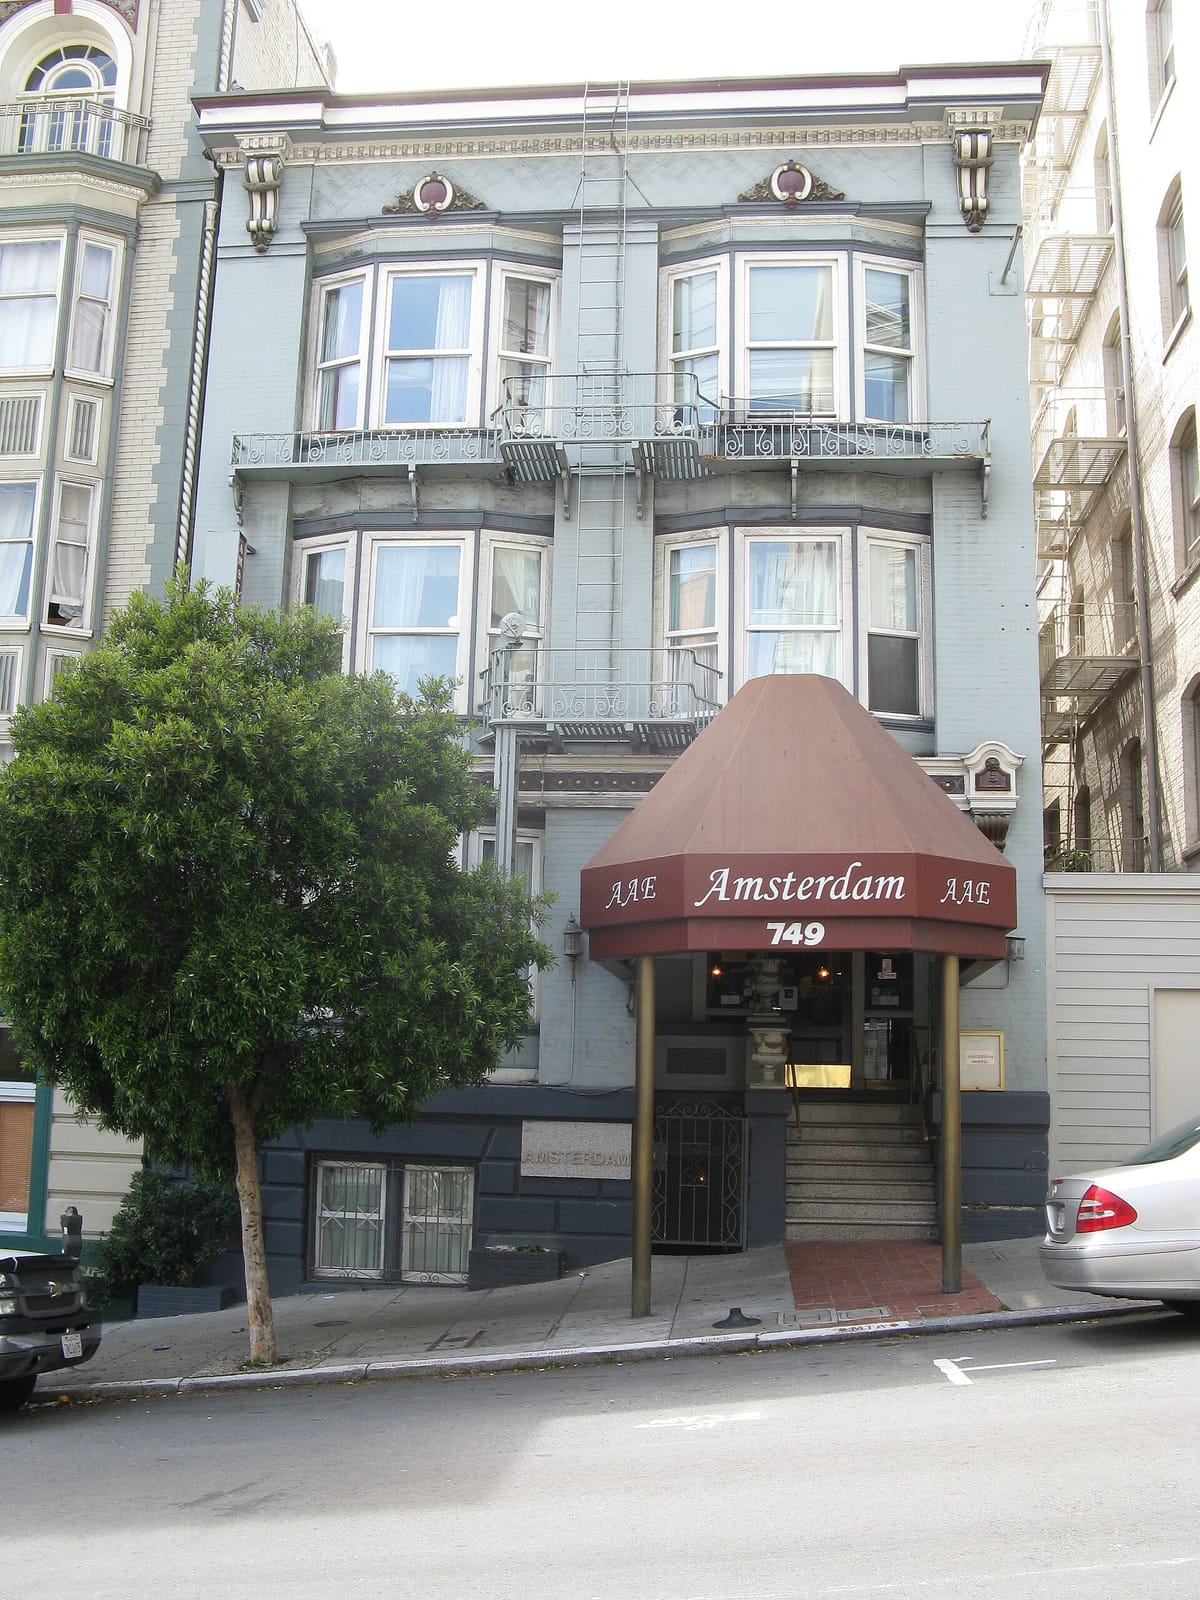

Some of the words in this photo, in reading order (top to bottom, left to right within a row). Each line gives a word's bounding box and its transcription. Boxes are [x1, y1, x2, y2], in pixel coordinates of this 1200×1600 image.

[605, 876, 657, 909] AAE
[693, 861, 906, 907] Amsterdam
[940, 878, 991, 905] AAE
[766, 921, 826, 946] 749
[521, 1151, 631, 1167] AMSTERDAM
